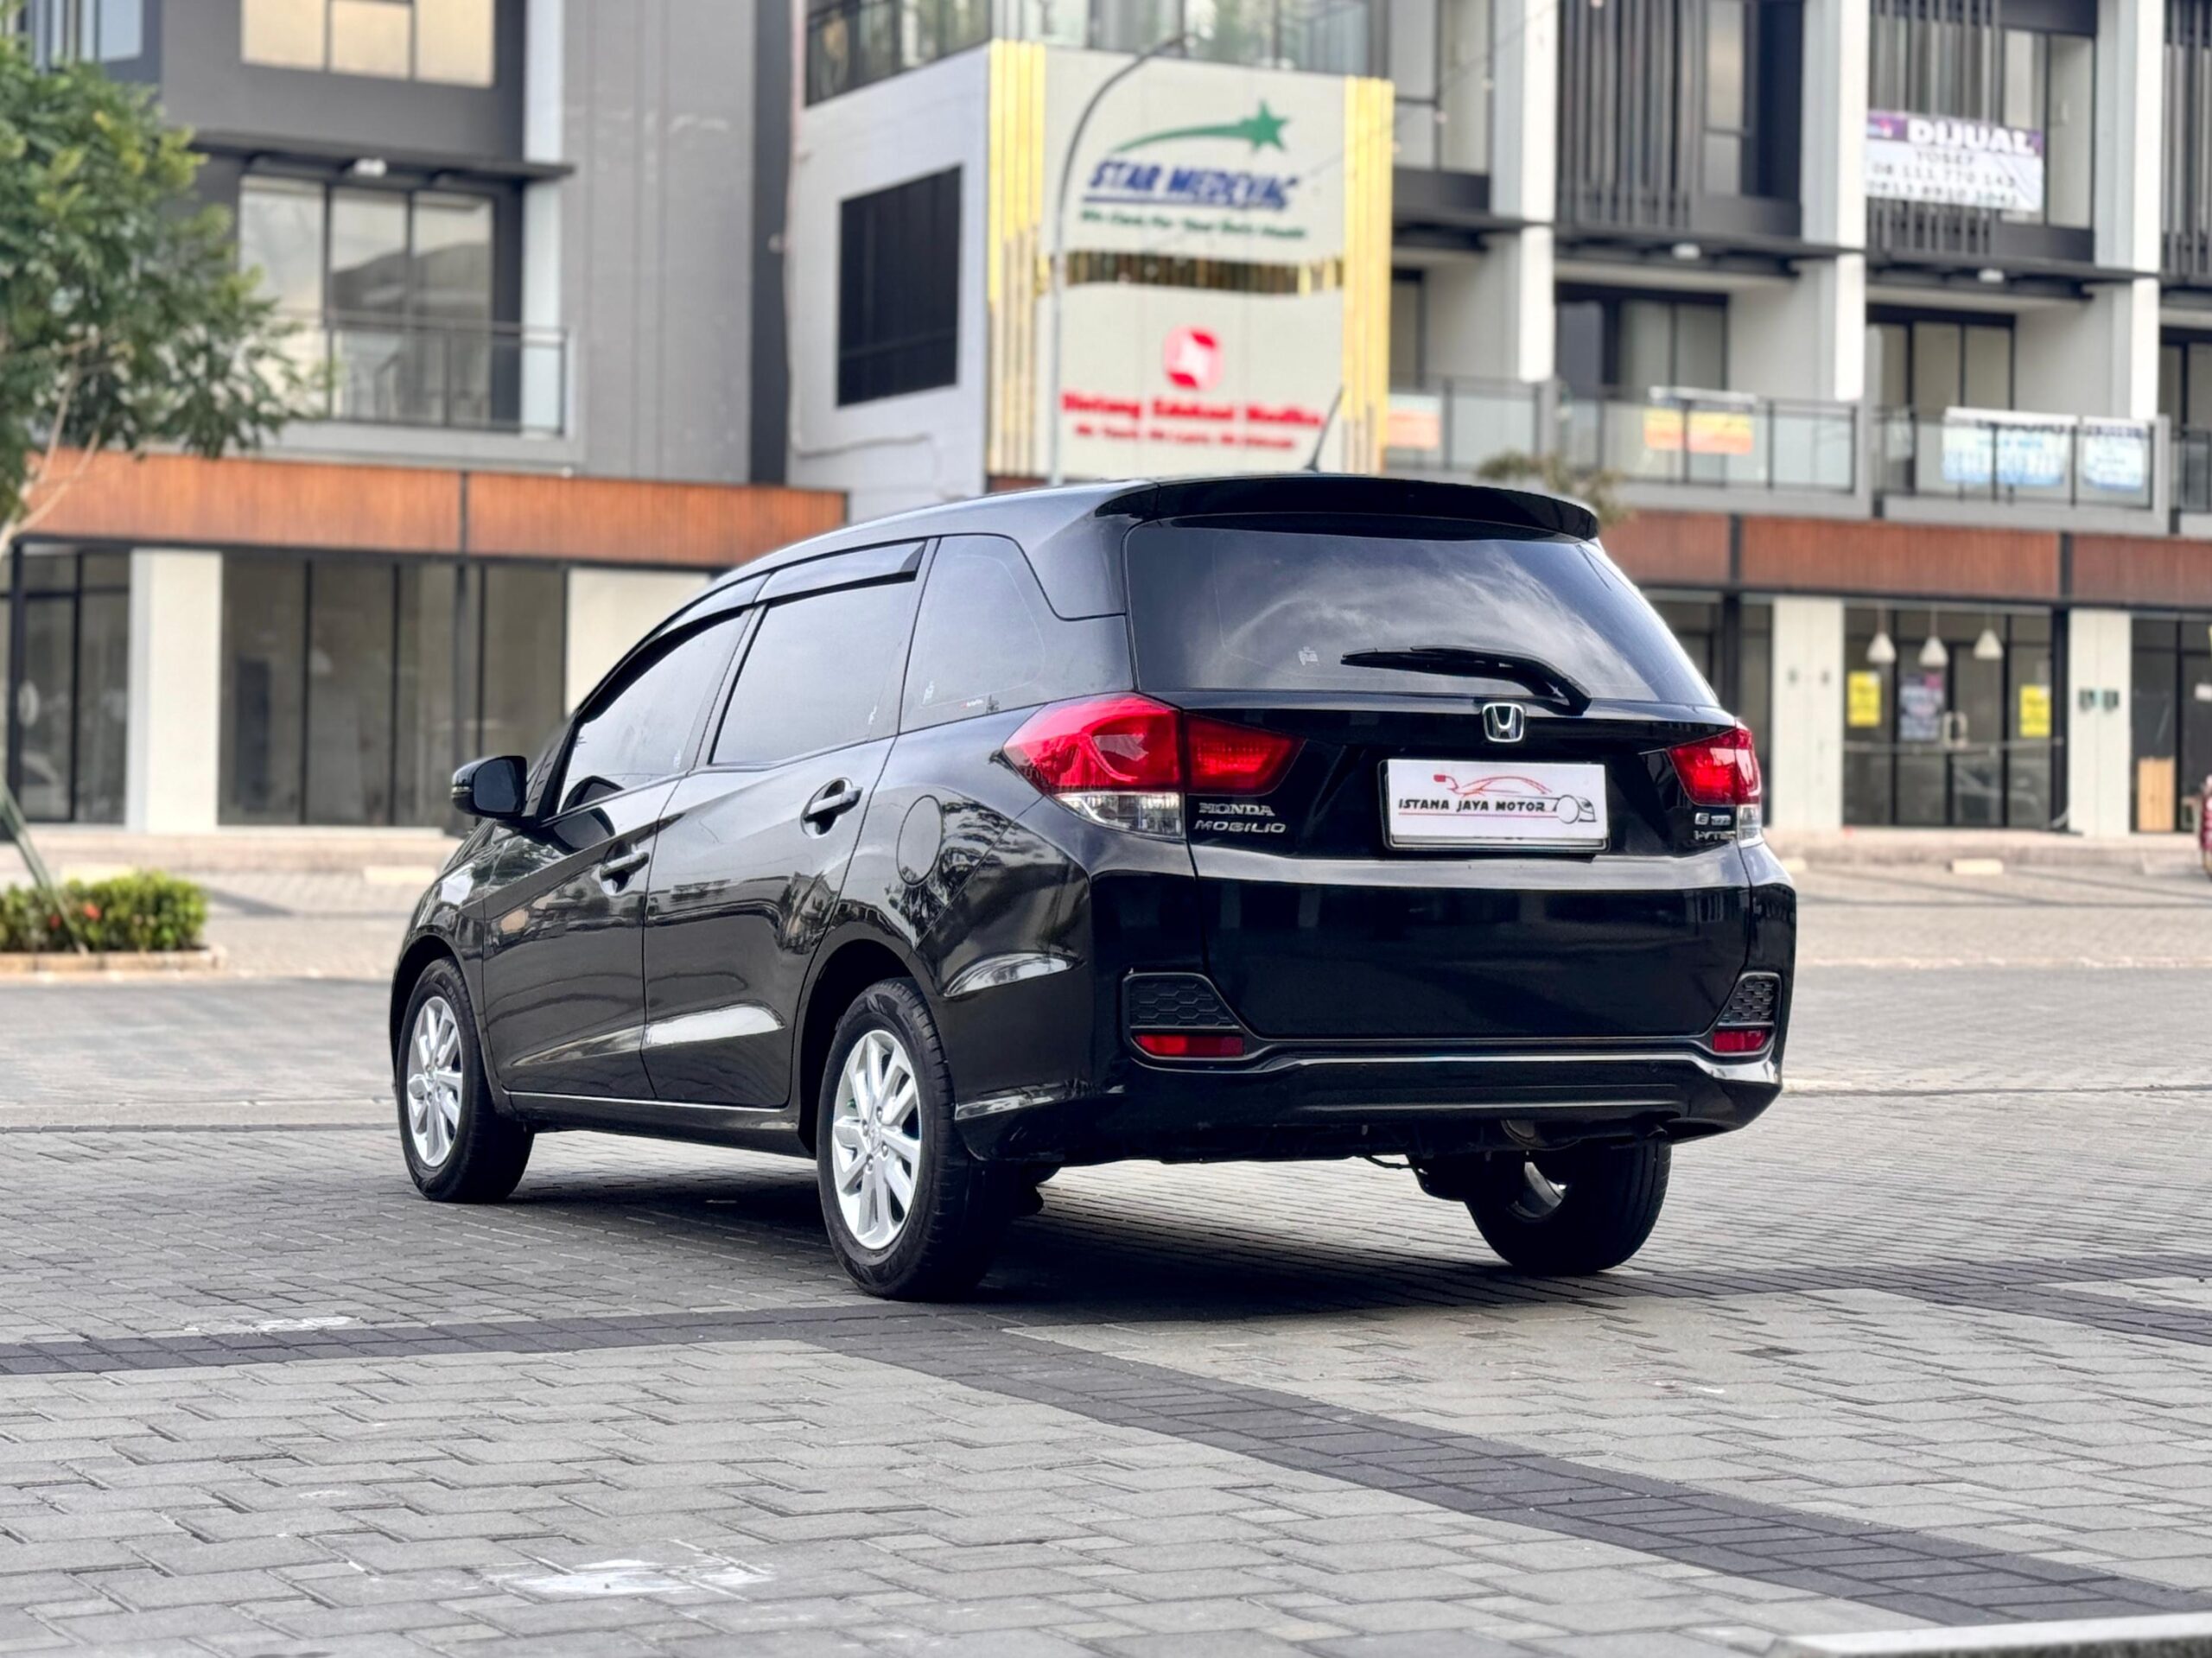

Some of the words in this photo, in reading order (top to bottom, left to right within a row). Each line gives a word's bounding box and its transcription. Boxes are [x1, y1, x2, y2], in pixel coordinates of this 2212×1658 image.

[1907, 118, 2034, 156] DIJUAL
[1090, 161, 1163, 191] STAR
[1198, 802, 1276, 816] HONDA
[1398, 798, 1449, 810] ISTANA
[1457, 799, 1489, 812] JAYA
[1495, 800, 1545, 812] MOTOR
[1194, 820, 1287, 834] MOBILIO
